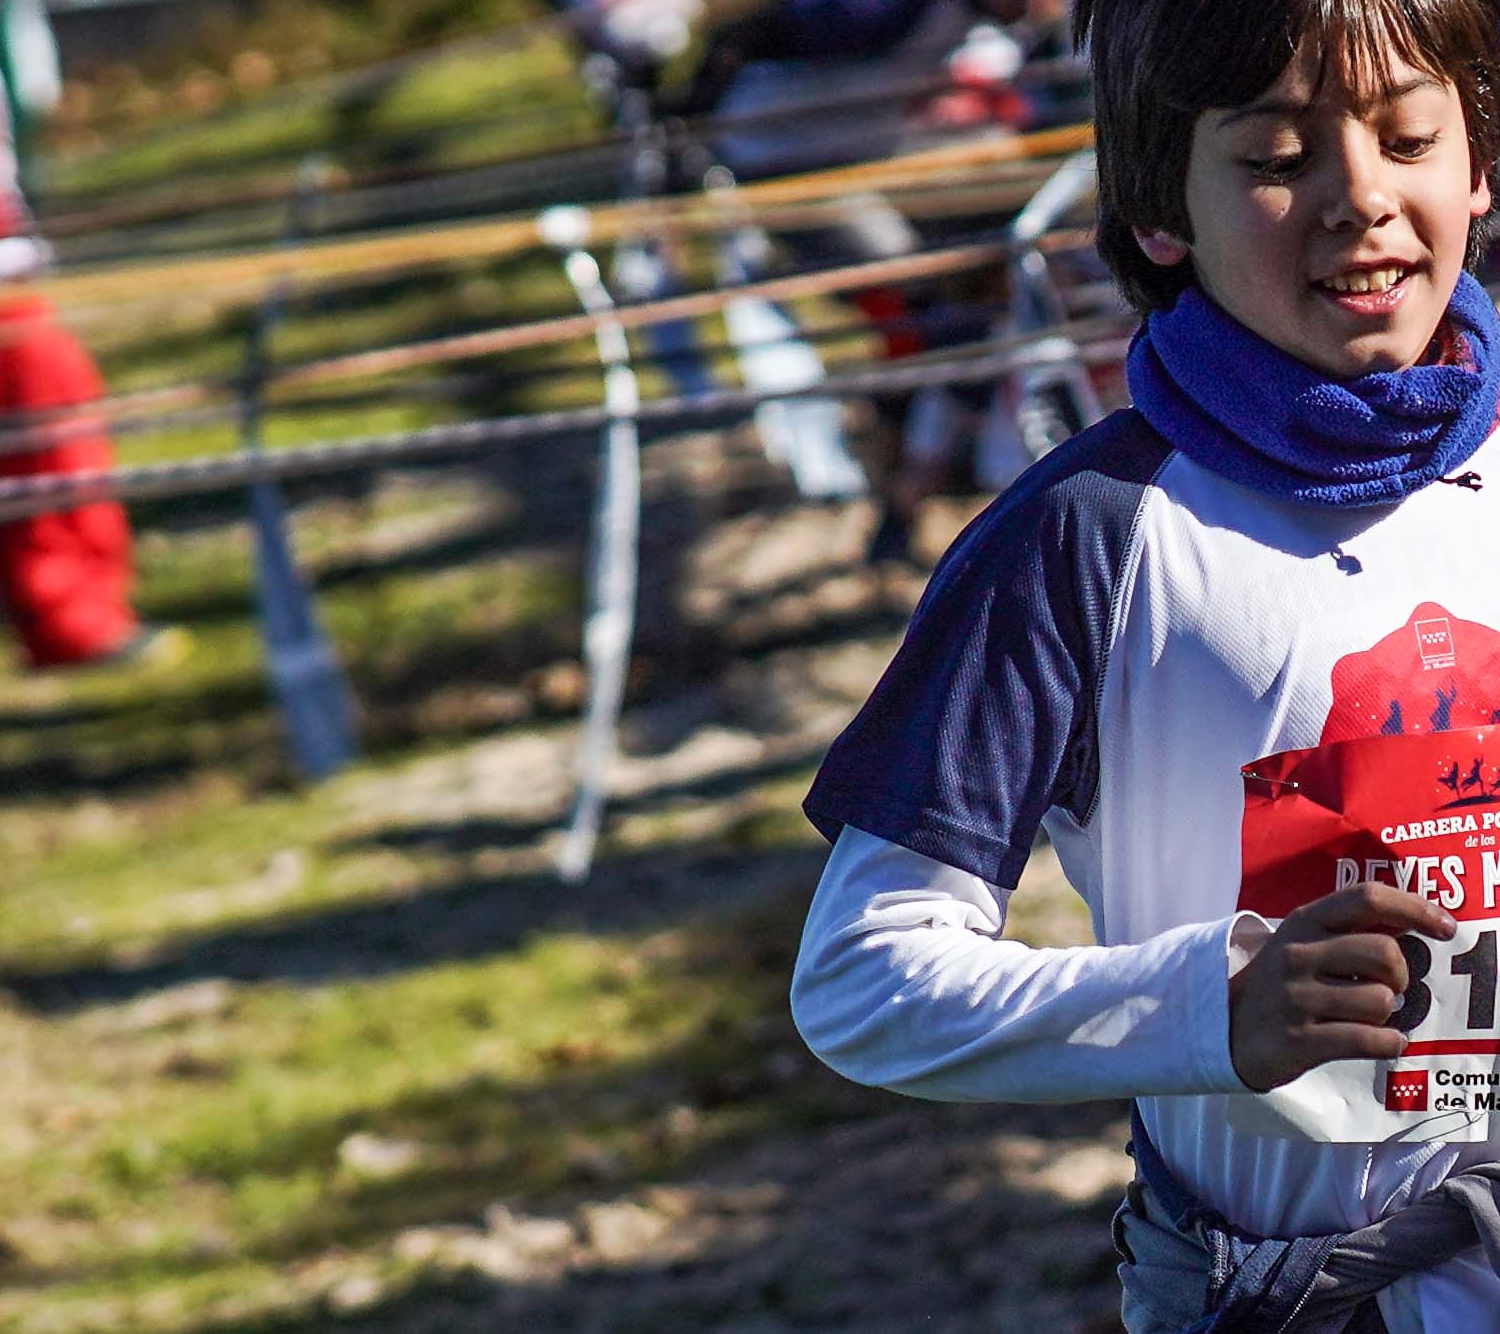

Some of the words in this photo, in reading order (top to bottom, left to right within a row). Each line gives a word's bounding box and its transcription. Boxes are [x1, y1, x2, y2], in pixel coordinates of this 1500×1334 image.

[1380, 814, 1478, 844] CARRERA
[1464, 835, 1479, 848] de
[1480, 833, 1496, 847] los
[1434, 1093, 1466, 1111] de
